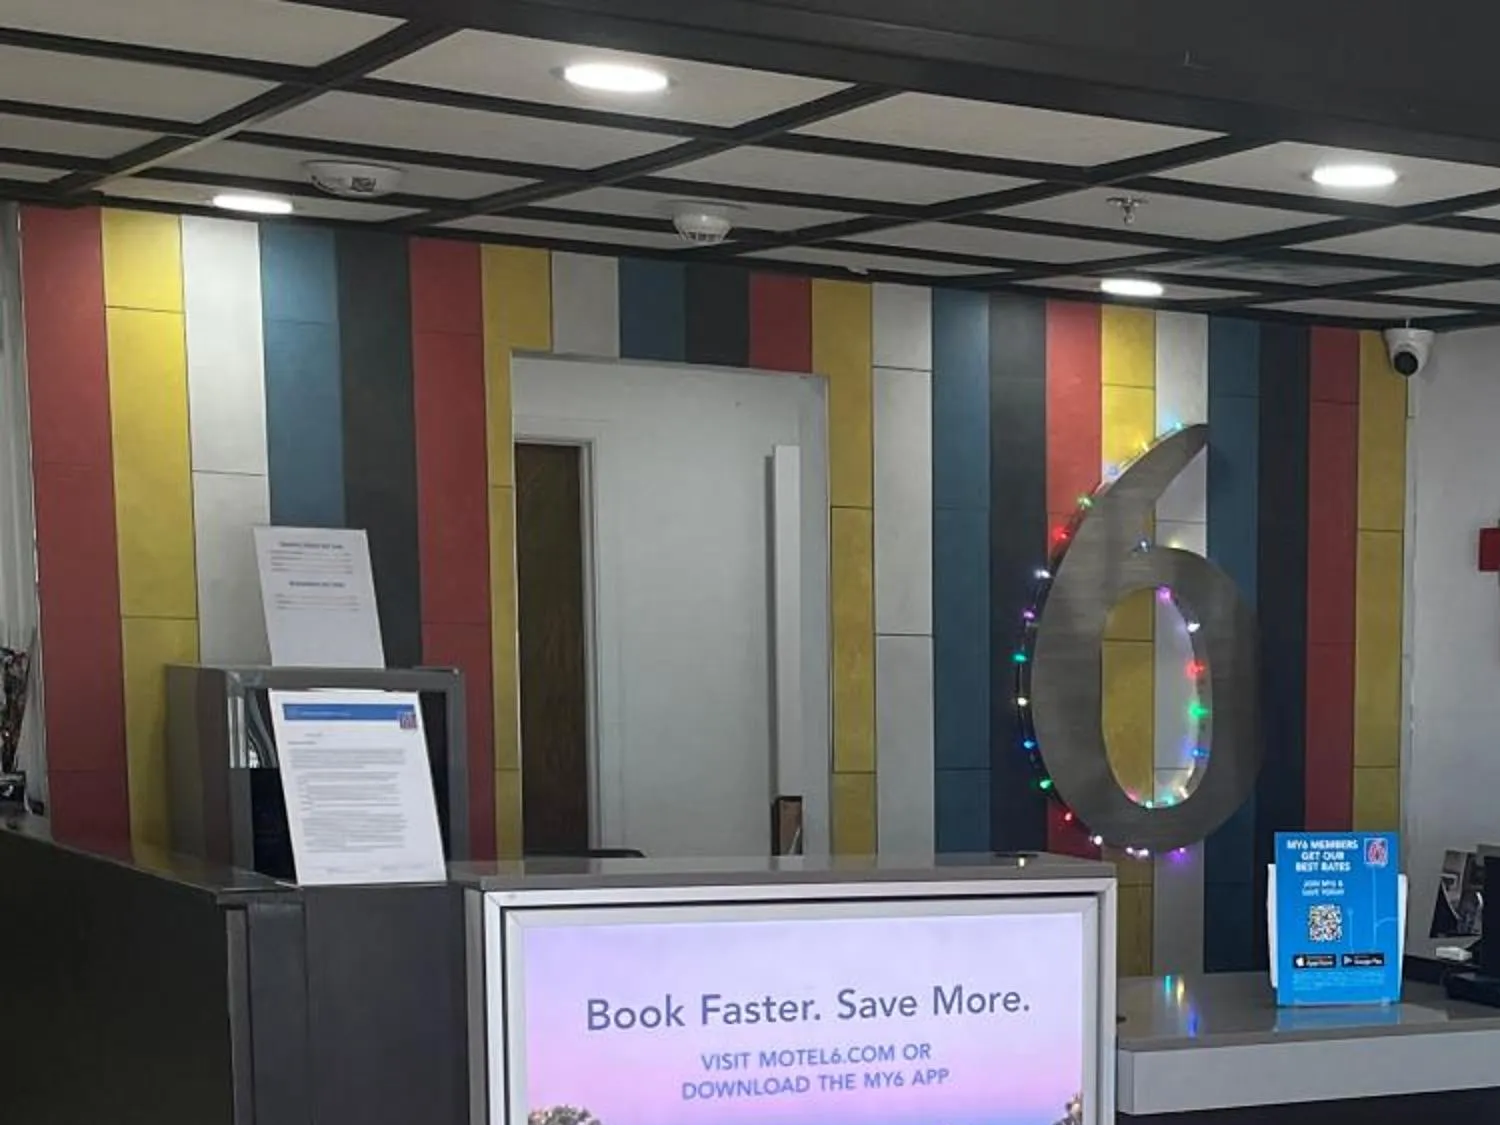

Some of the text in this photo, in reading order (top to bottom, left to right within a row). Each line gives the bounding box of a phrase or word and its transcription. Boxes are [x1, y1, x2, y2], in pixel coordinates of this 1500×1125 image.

[1031, 423, 1262, 851] 6
[1301, 851, 1345, 861] GET OUR
[1310, 839, 1359, 850] MEMBERS
[1295, 862, 1351, 872] BEST RATES
[586, 985, 1031, 1031] Book Faster. Save More.
[701, 1043, 932, 1071] VISIT MOTEL6.COM OR
[682, 1067, 950, 1100] DOWNLOAD THE MY6 APP
